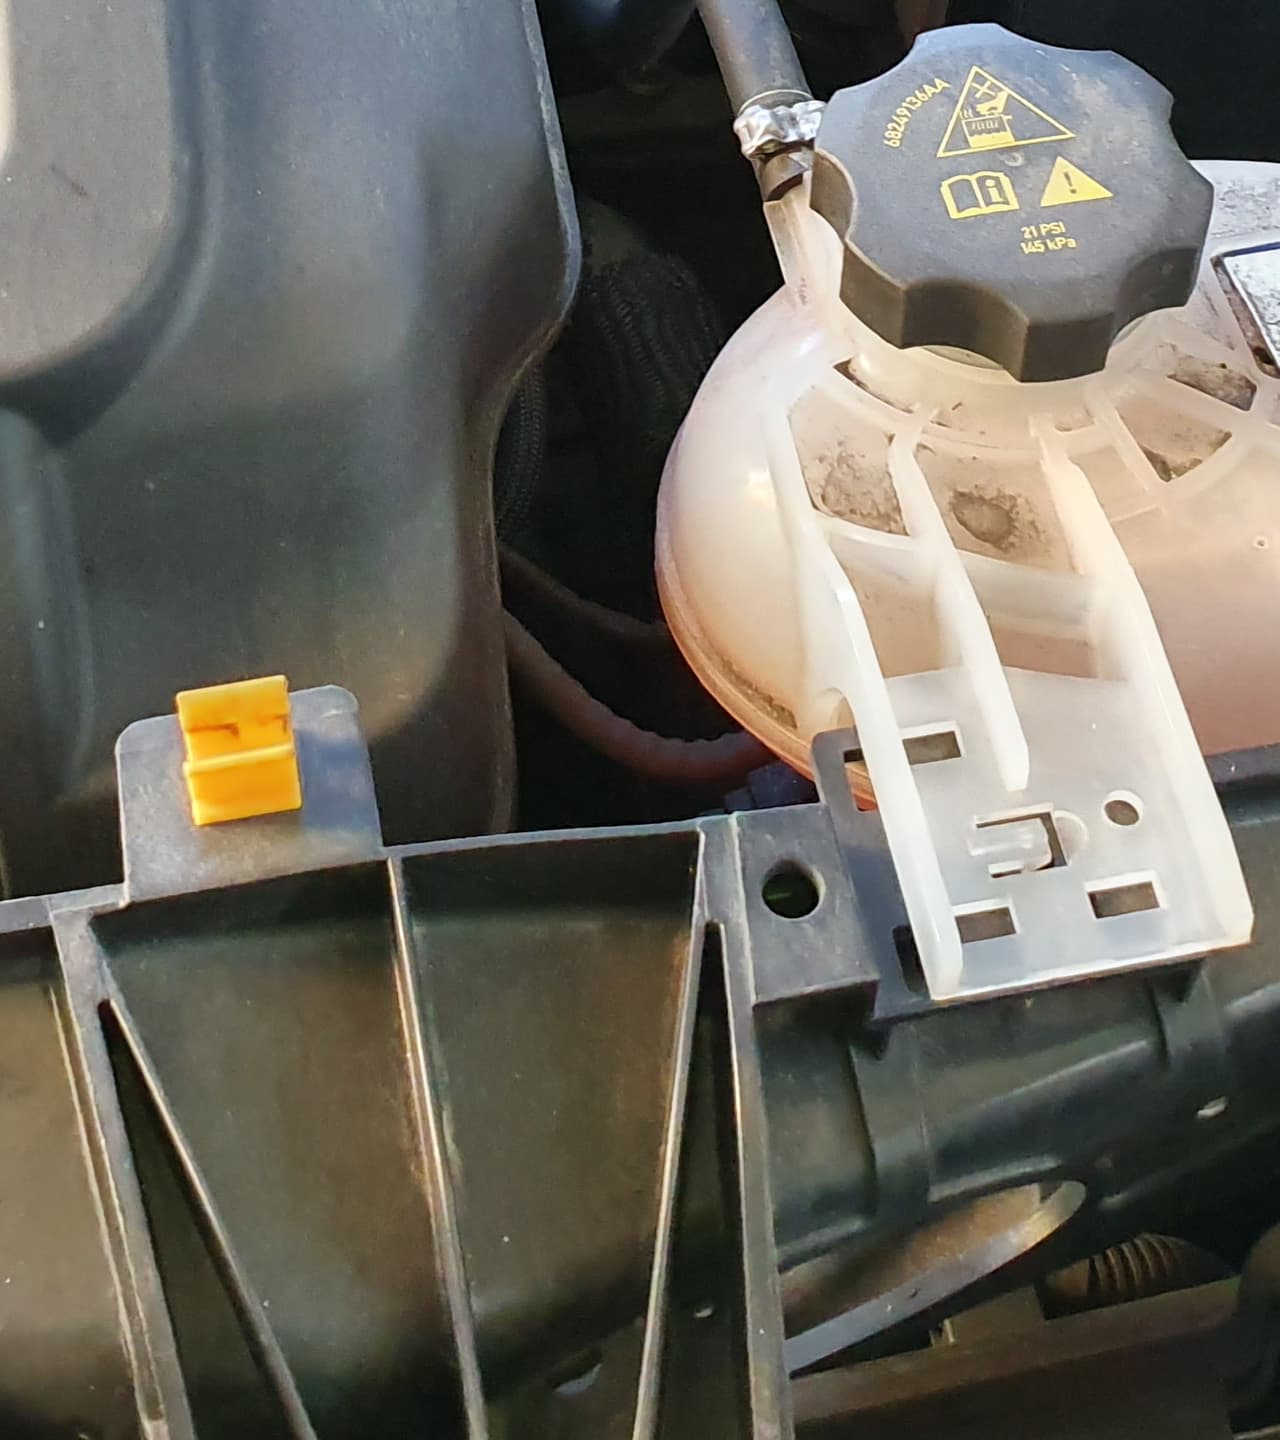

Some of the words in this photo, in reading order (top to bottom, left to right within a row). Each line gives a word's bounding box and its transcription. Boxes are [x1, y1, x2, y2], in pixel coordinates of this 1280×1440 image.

[883, 77, 952, 149] 68249136AA
[1021, 225, 1039, 240] 21
[1040, 221, 1066, 236] PSI
[1020, 240, 1045, 255] 145
[1047, 237, 1077, 252] kPa
